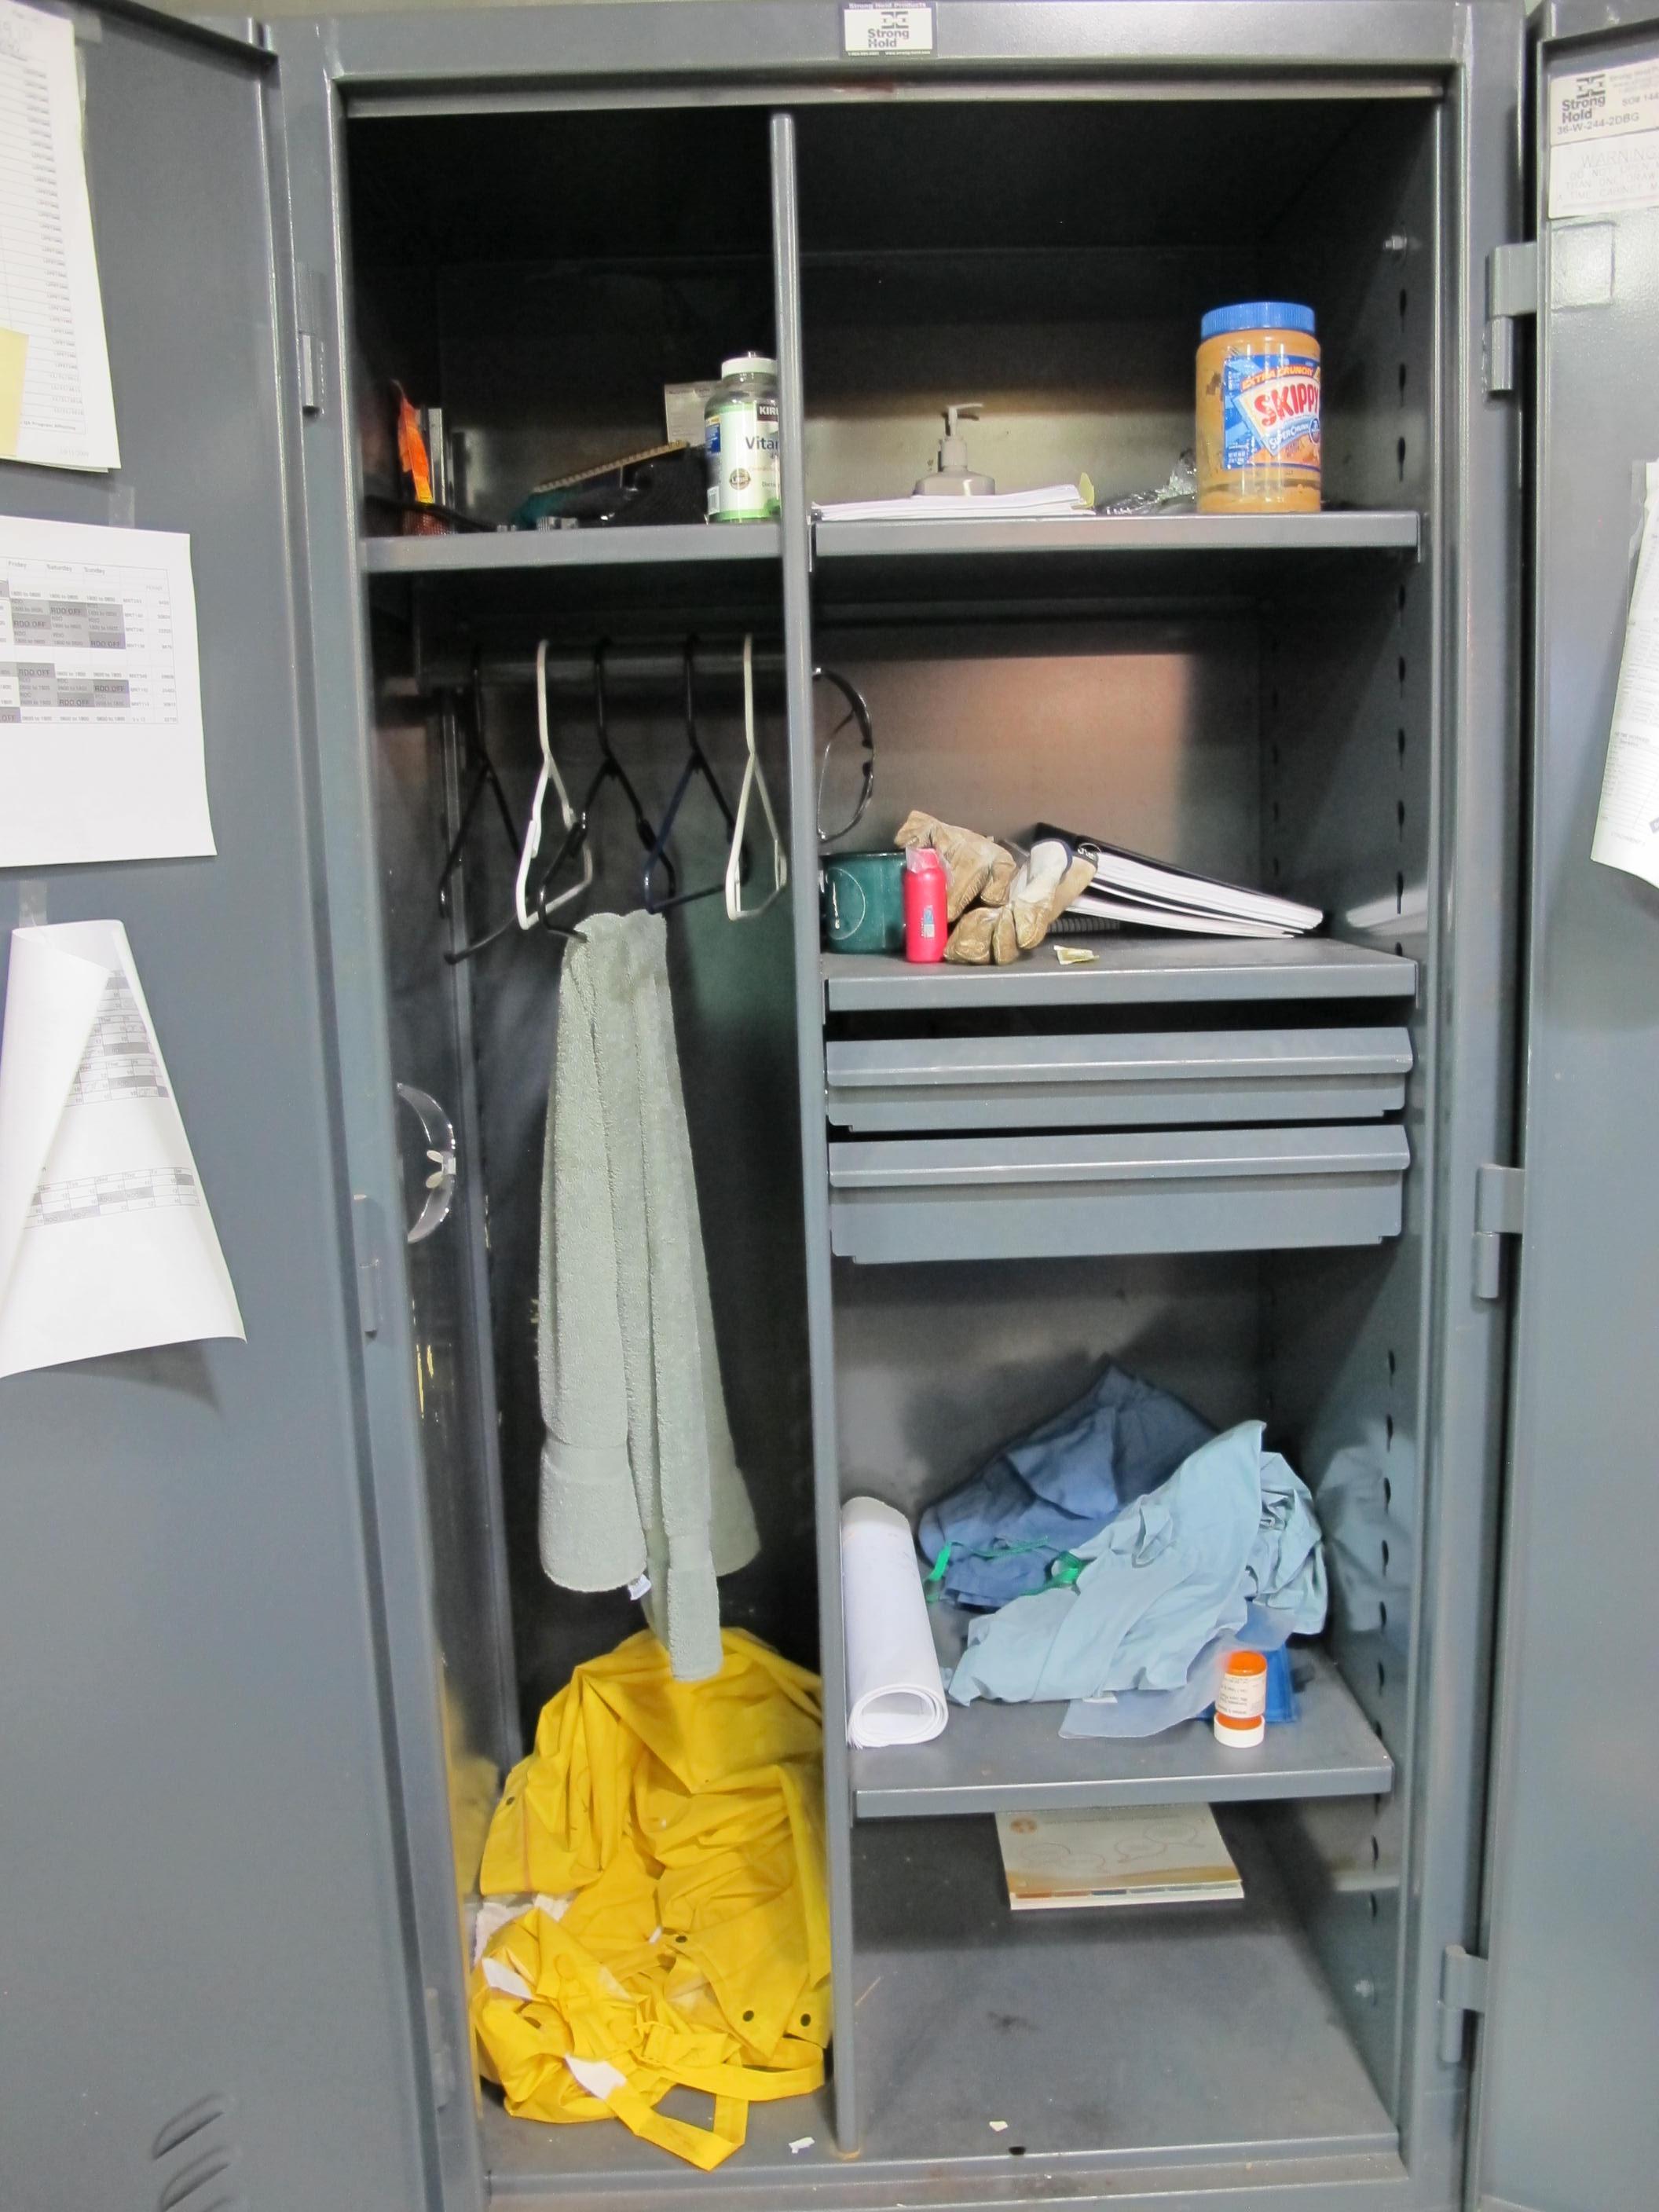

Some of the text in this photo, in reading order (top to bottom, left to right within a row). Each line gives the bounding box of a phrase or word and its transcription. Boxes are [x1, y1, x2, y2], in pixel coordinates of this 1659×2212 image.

[868, 28, 909, 39] Strong
[868, 38, 896, 47] Hold
[1562, 96, 1606, 112] Strong
[1562, 108, 1593, 124] Hold
[1242, 364, 1314, 390] EXTRA CRUNCHY
[1254, 383, 1319, 427] SKIPPY
[8, 559, 27, 570] Friday
[46, 563, 72, 573] Saturday
[84, 566, 105, 576] Sunday
